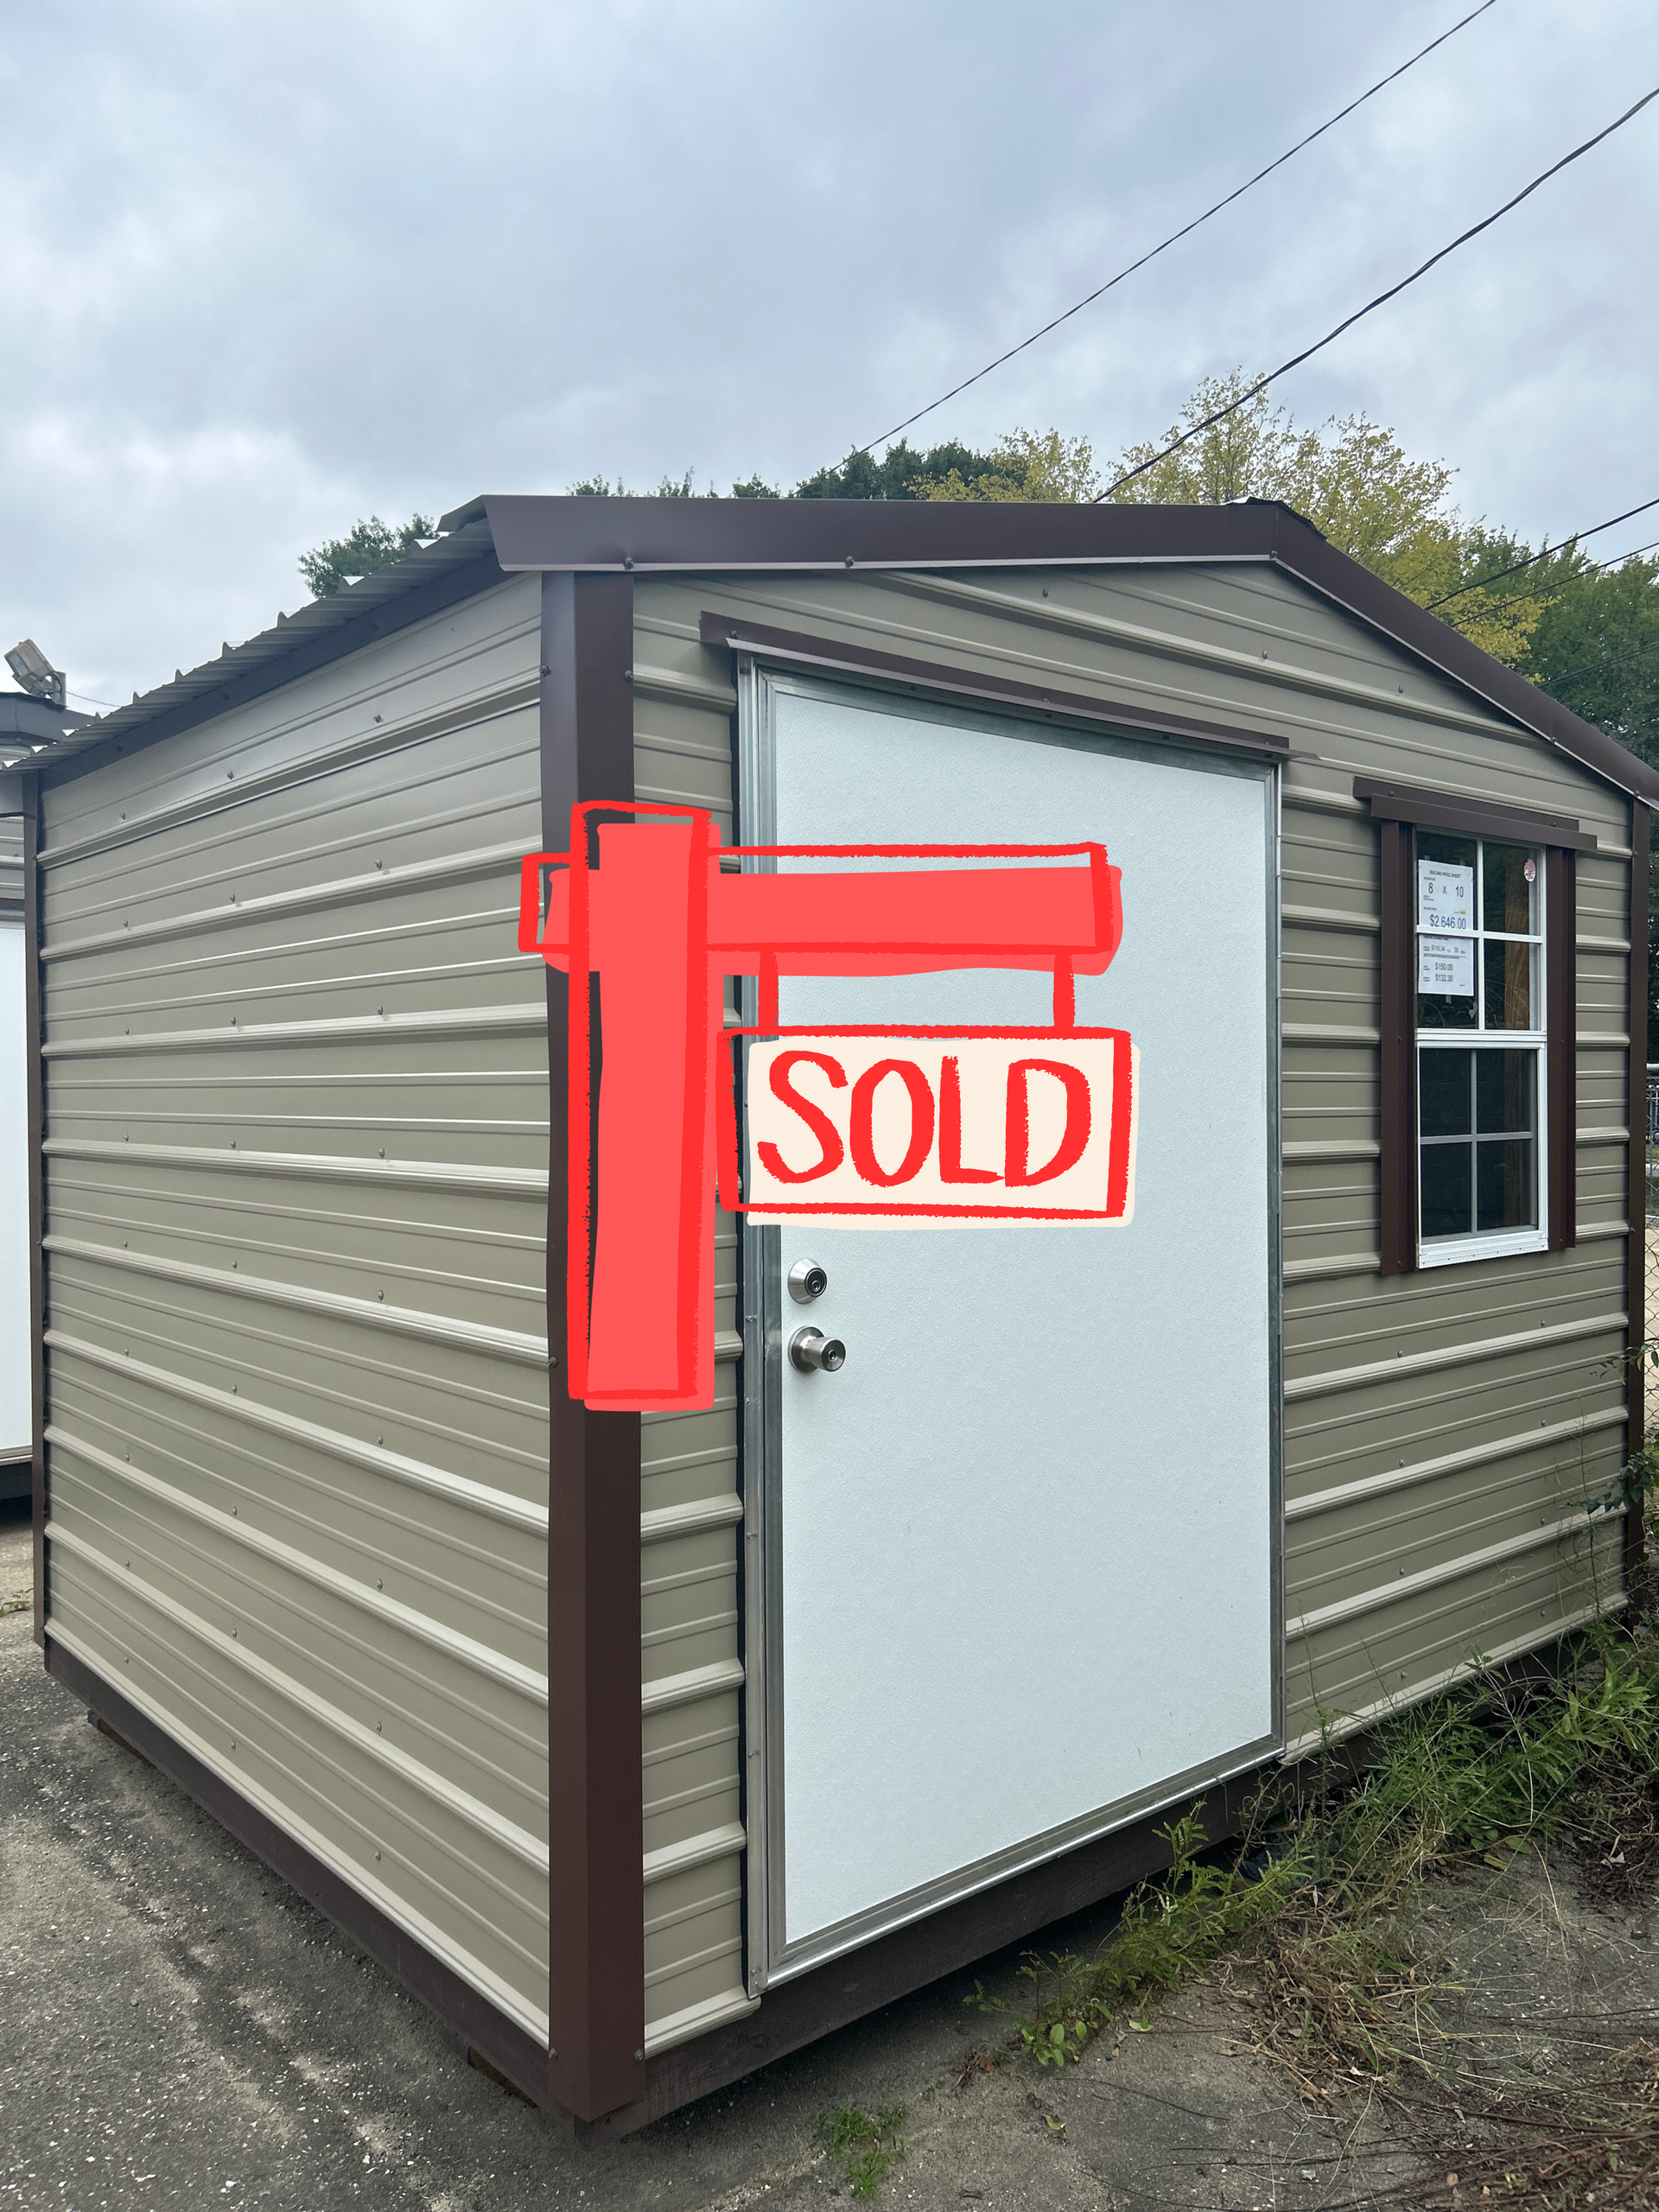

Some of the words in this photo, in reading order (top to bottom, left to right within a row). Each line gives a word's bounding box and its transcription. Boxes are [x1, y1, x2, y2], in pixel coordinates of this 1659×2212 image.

[1428, 882, 1434, 894] 8
[1455, 886, 1465, 898] 10
[1434, 962, 1453, 971] $150.00
